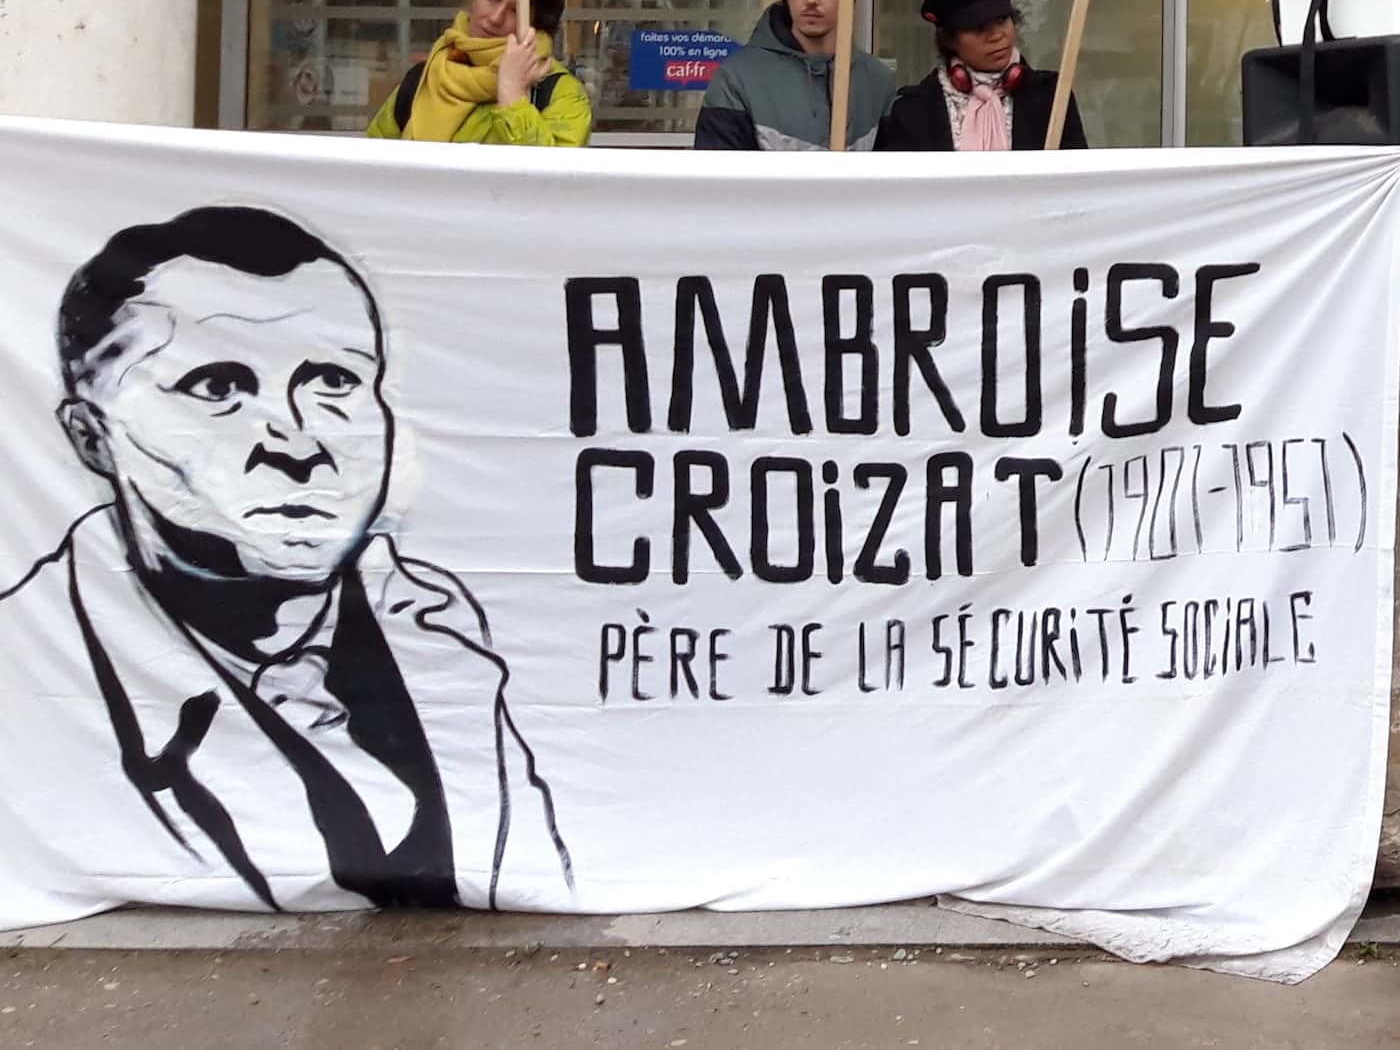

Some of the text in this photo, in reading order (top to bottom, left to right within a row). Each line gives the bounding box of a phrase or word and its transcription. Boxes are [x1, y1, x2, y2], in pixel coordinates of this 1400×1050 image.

[671, 33, 689, 43] vos
[659, 45, 729, 60] 100% en ligne
[598, 607, 733, 705] PÈRE
[767, 622, 823, 696] DE
[857, 618, 906, 693] LA
